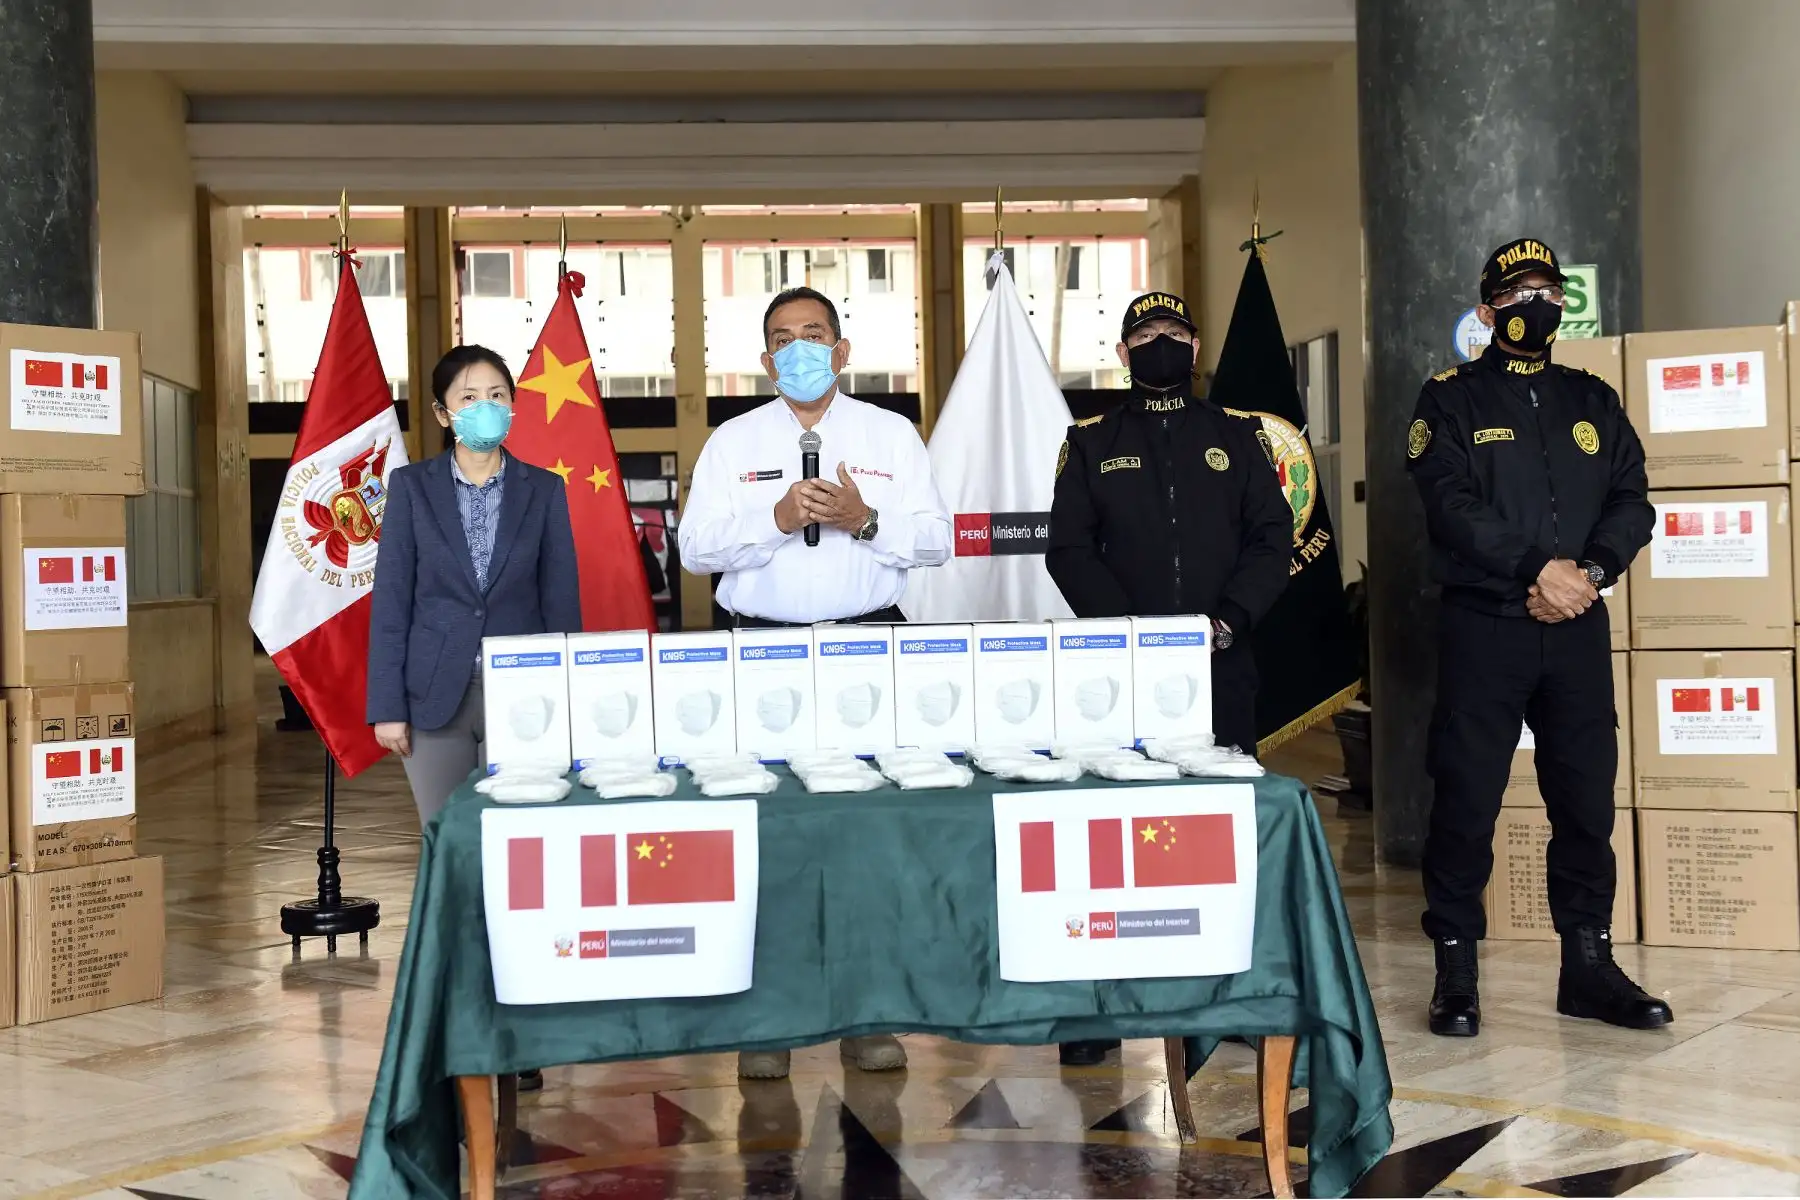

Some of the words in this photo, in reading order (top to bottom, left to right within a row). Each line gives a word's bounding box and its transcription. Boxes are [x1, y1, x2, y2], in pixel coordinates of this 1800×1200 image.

[1497, 240, 1554, 272] POLICIA
[1562, 274, 1588, 314] S
[1133, 294, 1184, 317] POLICIA
[1507, 360, 1546, 374] POLICIA
[1145, 397, 1186, 411] POLICIA
[280, 461, 321, 508] POLICIA
[960, 526, 988, 540] PERÚ
[992, 524, 1031, 540] Ministerio
[1034, 523, 1049, 539] del
[281, 515, 318, 574] NACIONAL
[1300, 527, 1331, 563] PERU
[320, 568, 343, 588] DEL
[984, 640, 1006, 650] KN95
[1064, 638, 1086, 647] KN95
[1142, 635, 1164, 644] KN95
[744, 648, 766, 658] KN95
[824, 644, 846, 654] KN95
[904, 642, 926, 652] KN95
[494, 656, 518, 666] KN95
[578, 652, 601, 662] KN95
[662, 651, 686, 661] KN95
[38, 832, 68, 841] MODEL:
[1091, 920, 1114, 932] PERÚ
[1120, 920, 1152, 928] Ministerio
[581, 939, 605, 950] PERÚ
[610, 938, 646, 947] Ministerio
